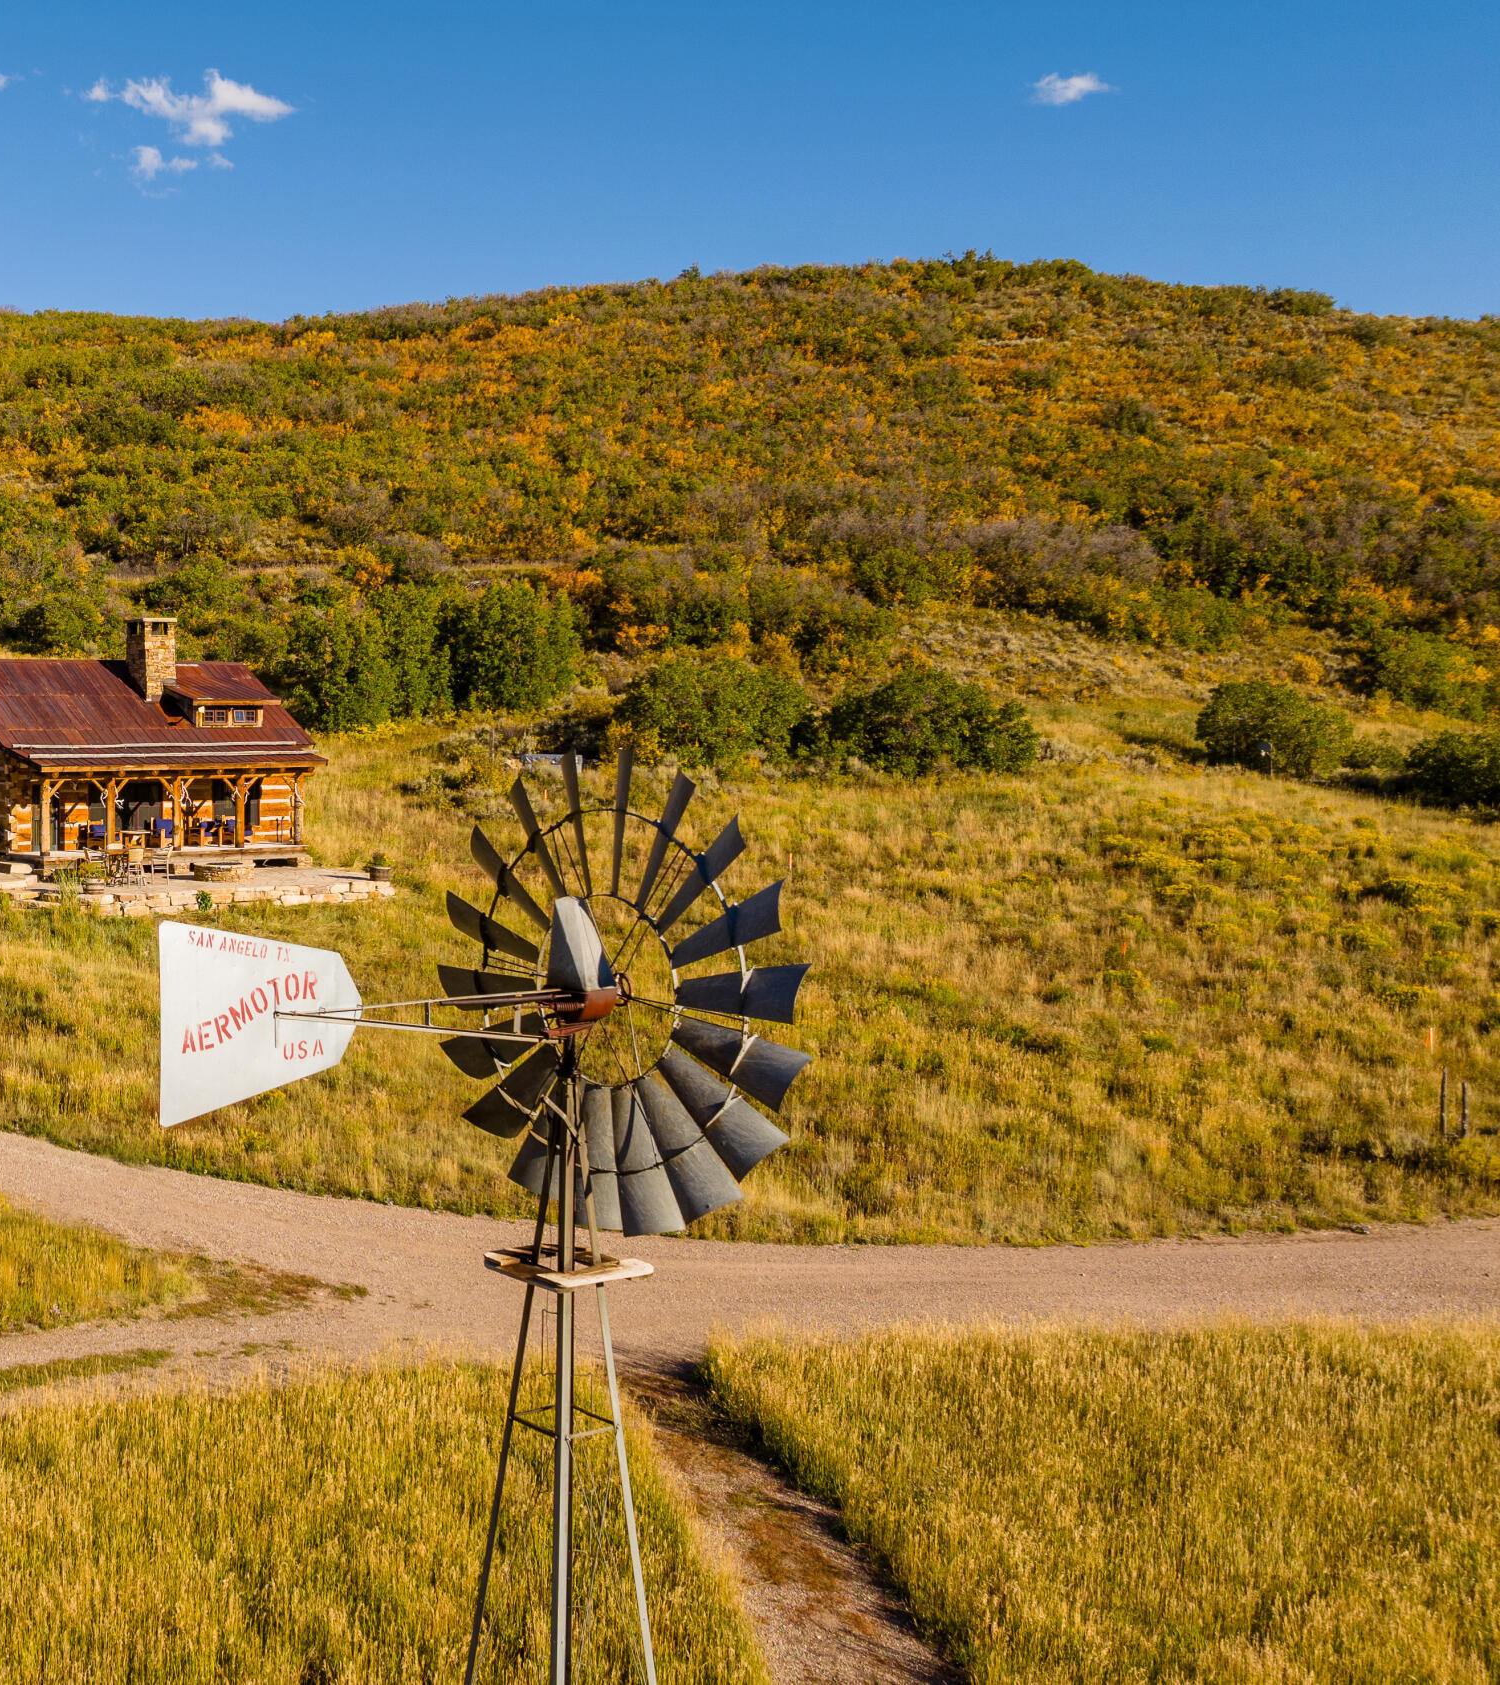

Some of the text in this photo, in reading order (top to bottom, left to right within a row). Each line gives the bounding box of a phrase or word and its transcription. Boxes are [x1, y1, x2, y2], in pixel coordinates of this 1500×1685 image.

[187, 930, 215, 949] SAN
[219, 936, 268, 959] ANGELO
[181, 970, 318, 1054] AERMOTOR
[283, 1039, 324, 1060] USA
